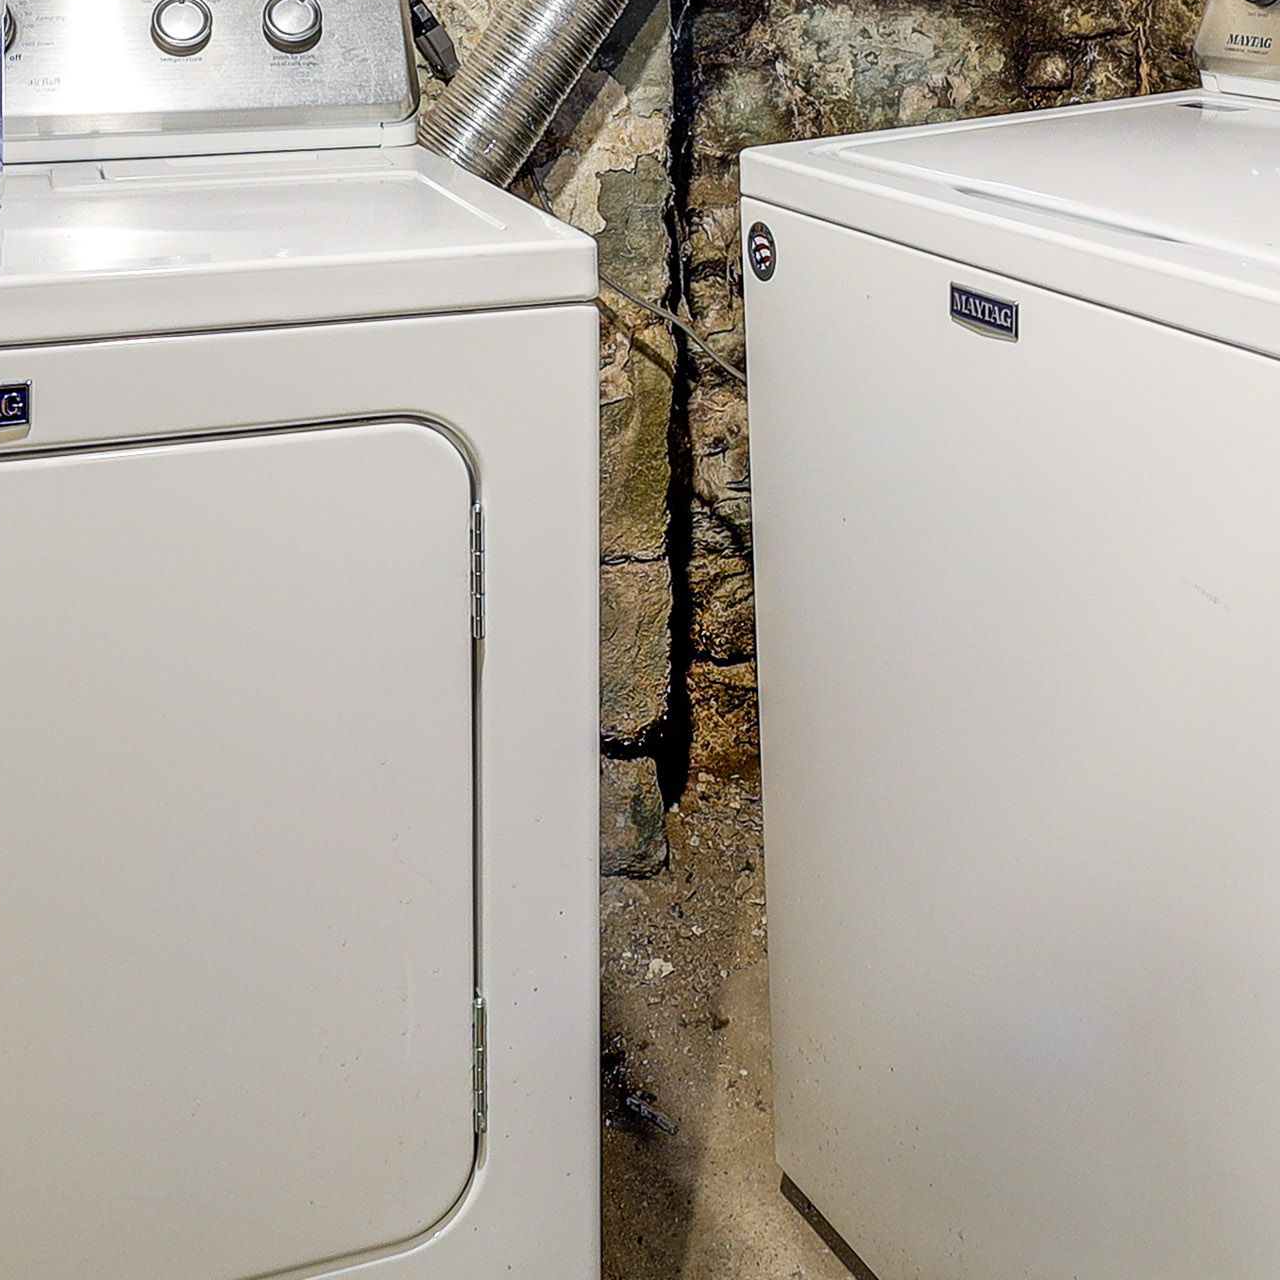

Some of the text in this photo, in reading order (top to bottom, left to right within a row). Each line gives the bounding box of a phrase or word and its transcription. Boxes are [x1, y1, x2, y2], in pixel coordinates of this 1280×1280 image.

[1226, 33, 1273, 49] MAYTAG
[9, 53, 22, 61] off
[953, 292, 1012, 328] MAYTAG
